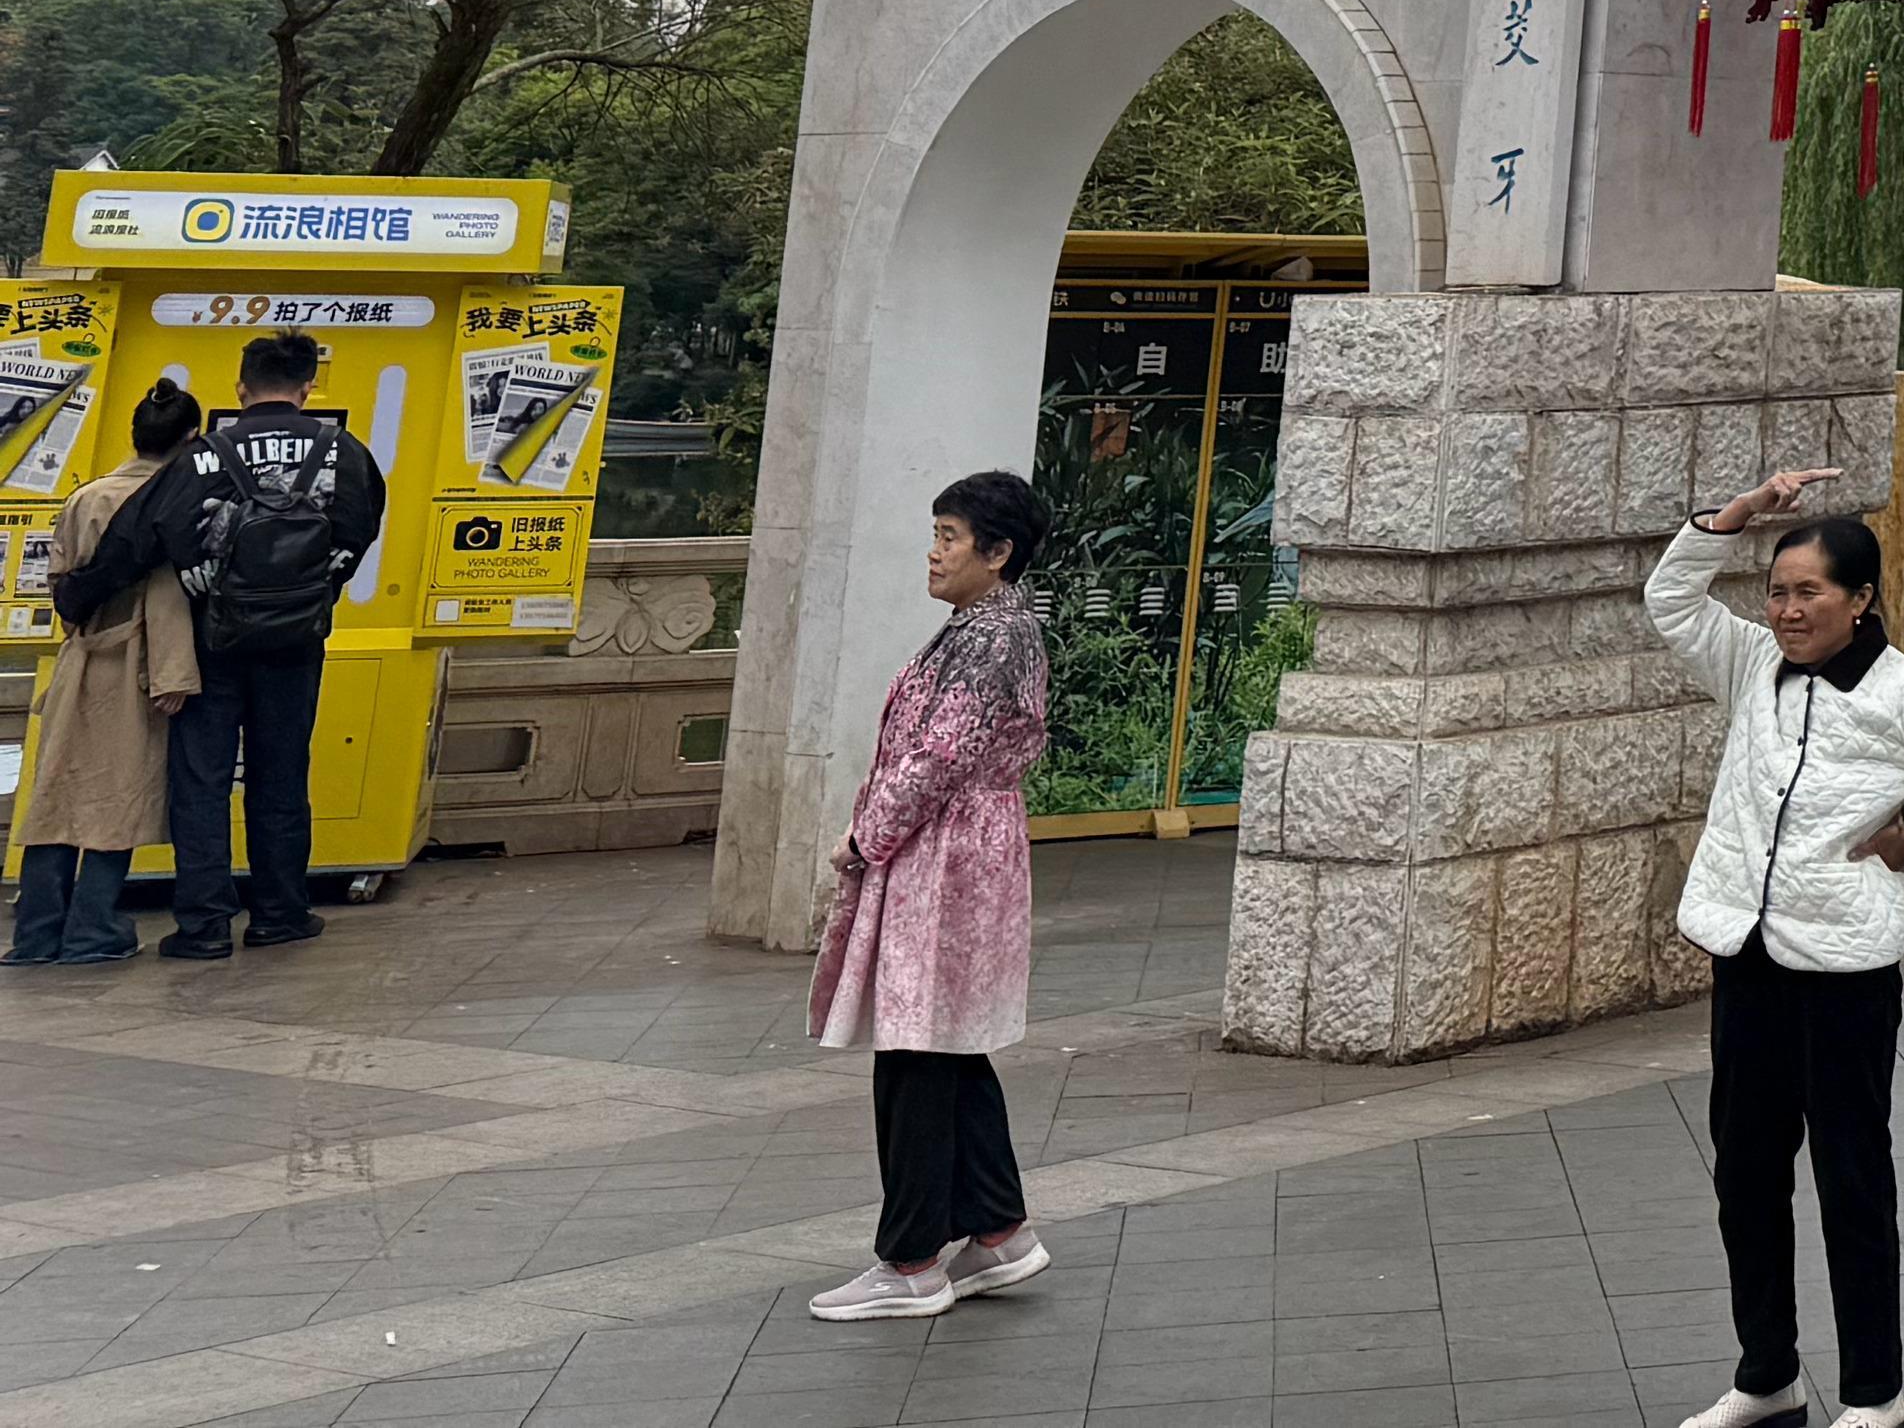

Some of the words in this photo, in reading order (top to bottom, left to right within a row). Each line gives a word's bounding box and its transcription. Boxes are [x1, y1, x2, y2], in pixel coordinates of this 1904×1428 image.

[239, 205, 413, 242] 流浪相馆
[432, 212, 500, 222] WANDERING
[445, 230, 496, 239] GALLERY
[459, 222, 499, 230] PHOTO
[273, 301, 394, 323] 拍了个报纸
[465, 306, 599, 339] 我要上头条
[1136, 342, 1168, 376] 自
[1, 361, 55, 379] WORLD
[513, 363, 565, 382] WORLD
[192, 436, 338, 475] WLLBEI
[511, 516, 566, 533] 旧报纸
[508, 535, 563, 552] 上头条
[467, 556, 540, 567] WANDERING
[453, 569, 496, 579] PHOTO
[498, 568, 551, 579] GALLERY
